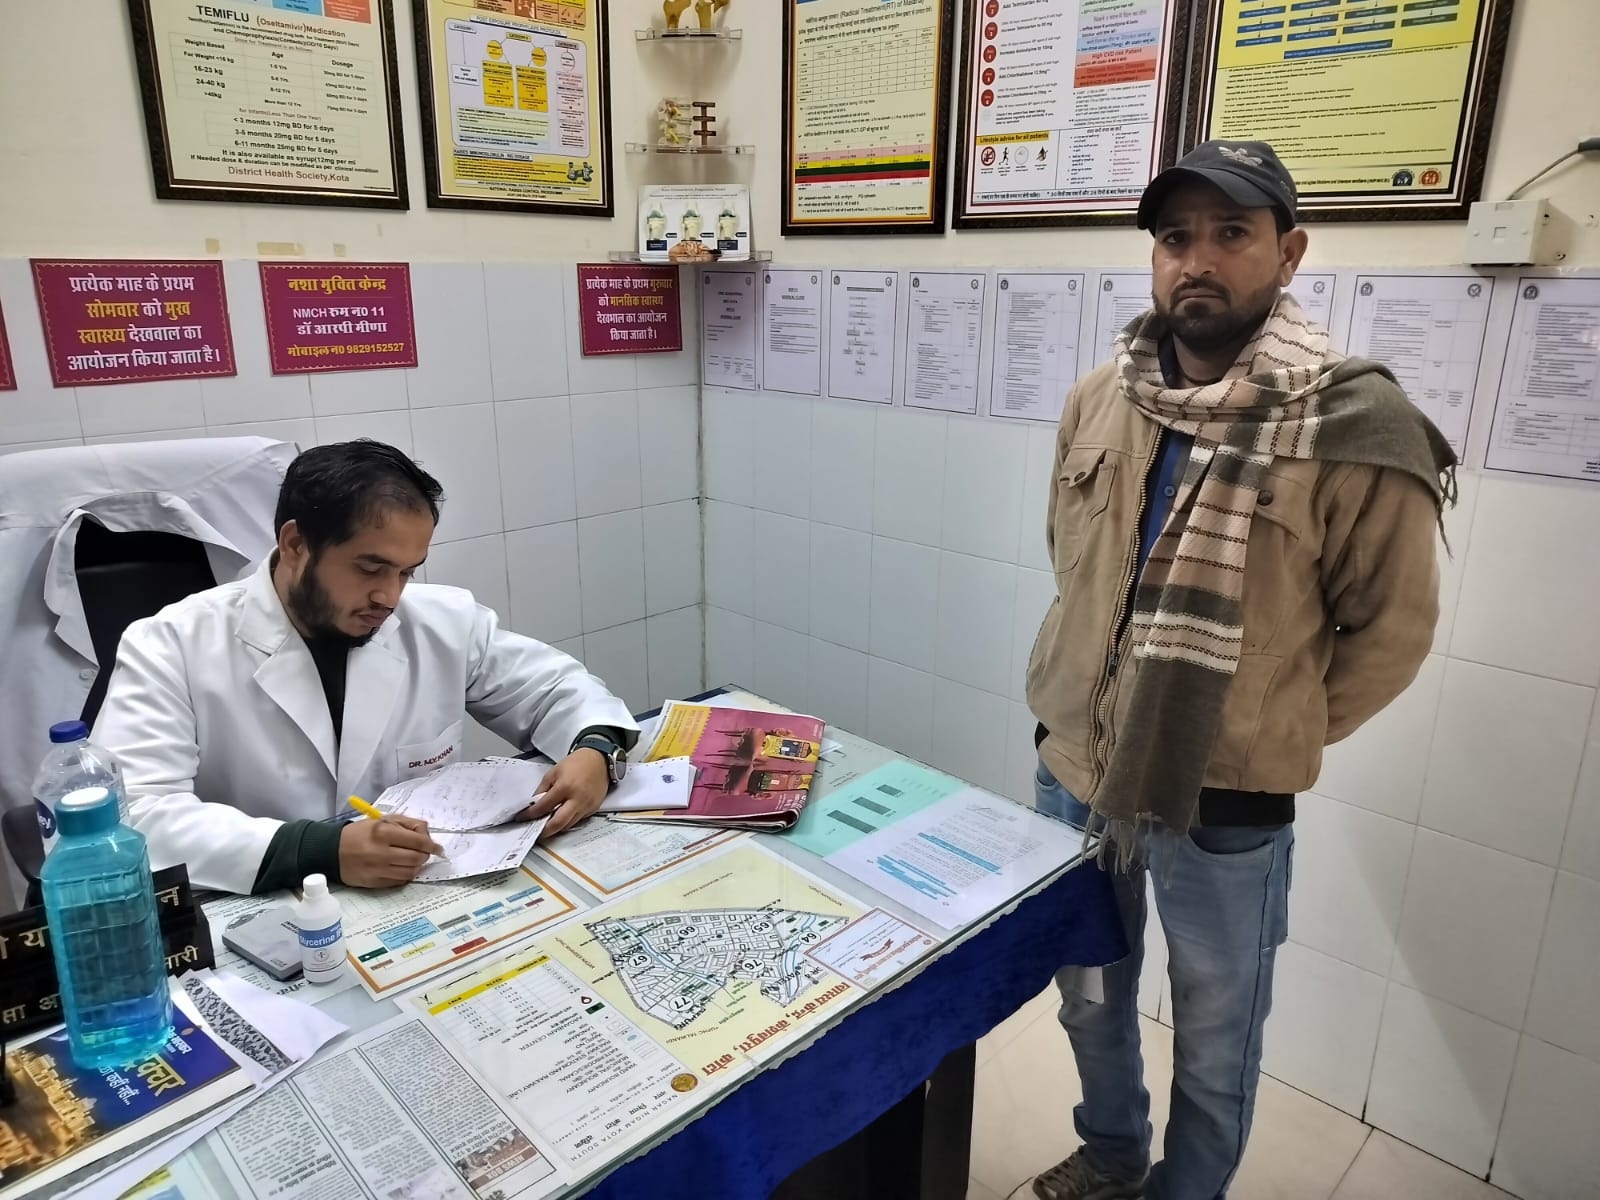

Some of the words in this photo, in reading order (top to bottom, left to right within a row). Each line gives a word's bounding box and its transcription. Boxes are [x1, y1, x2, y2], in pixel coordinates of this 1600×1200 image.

[196, 5, 249, 22] TEMIFLU
[271, 51, 284, 59] Age
[214, 67, 224, 76] kg
[216, 80, 226, 89] kg
[245, 118, 271, 126] months
[247, 130, 273, 138] months
[254, 152, 285, 160] available
[323, 148, 339, 156] days
[228, 166, 262, 177] District
[264, 168, 294, 180] Health
[68, 272, 114, 292] प्रत्येक
[115, 277, 143, 292] माह
[144, 272, 160, 292] के
[162, 276, 196, 292] प्रथम
[287, 278, 319, 291] नशा
[358, 274, 387, 291] केन्द्र
[586, 275, 609, 290] प्रत्येक
[609, 279, 624, 290] माह
[623, 276, 632, 289] के
[632, 279, 650, 290] प्रथम
[597, 293, 610, 307] को
[610, 293, 640, 307] मानसिक
[85, 299, 140, 318] सोमवार
[141, 298, 163, 317] को
[164, 301, 192, 321] मुख
[293, 308, 327, 318] NMCH
[370, 306, 385, 317] 11
[596, 311, 625, 325] देखभाल
[625, 313, 636, 323] का
[637, 309, 667, 323] आयोजन
[296, 321, 312, 335] डॉ
[313, 320, 354, 334] आरपी
[354, 320, 388, 333] मीणा
[610, 327, 629, 341] किया
[629, 329, 647, 340] जाता
[77, 328, 127, 344] स्वास्थ्य
[182, 325, 203, 340] का
[287, 344, 330, 357] मोबाइल
[346, 342, 405, 354] 9829152527
[67, 350, 130, 371] आयोजन
[131, 348, 168, 367] किया
[168, 349, 200, 365] जाता
[679, 926, 696, 936] 66
[754, 922, 770, 933] 65
[801, 932, 817, 943] 64
[634, 955, 648, 966] 67
[744, 959, 762, 971] 76
[675, 997, 691, 1010] 77
[701, 1053, 736, 1077] कोटा
